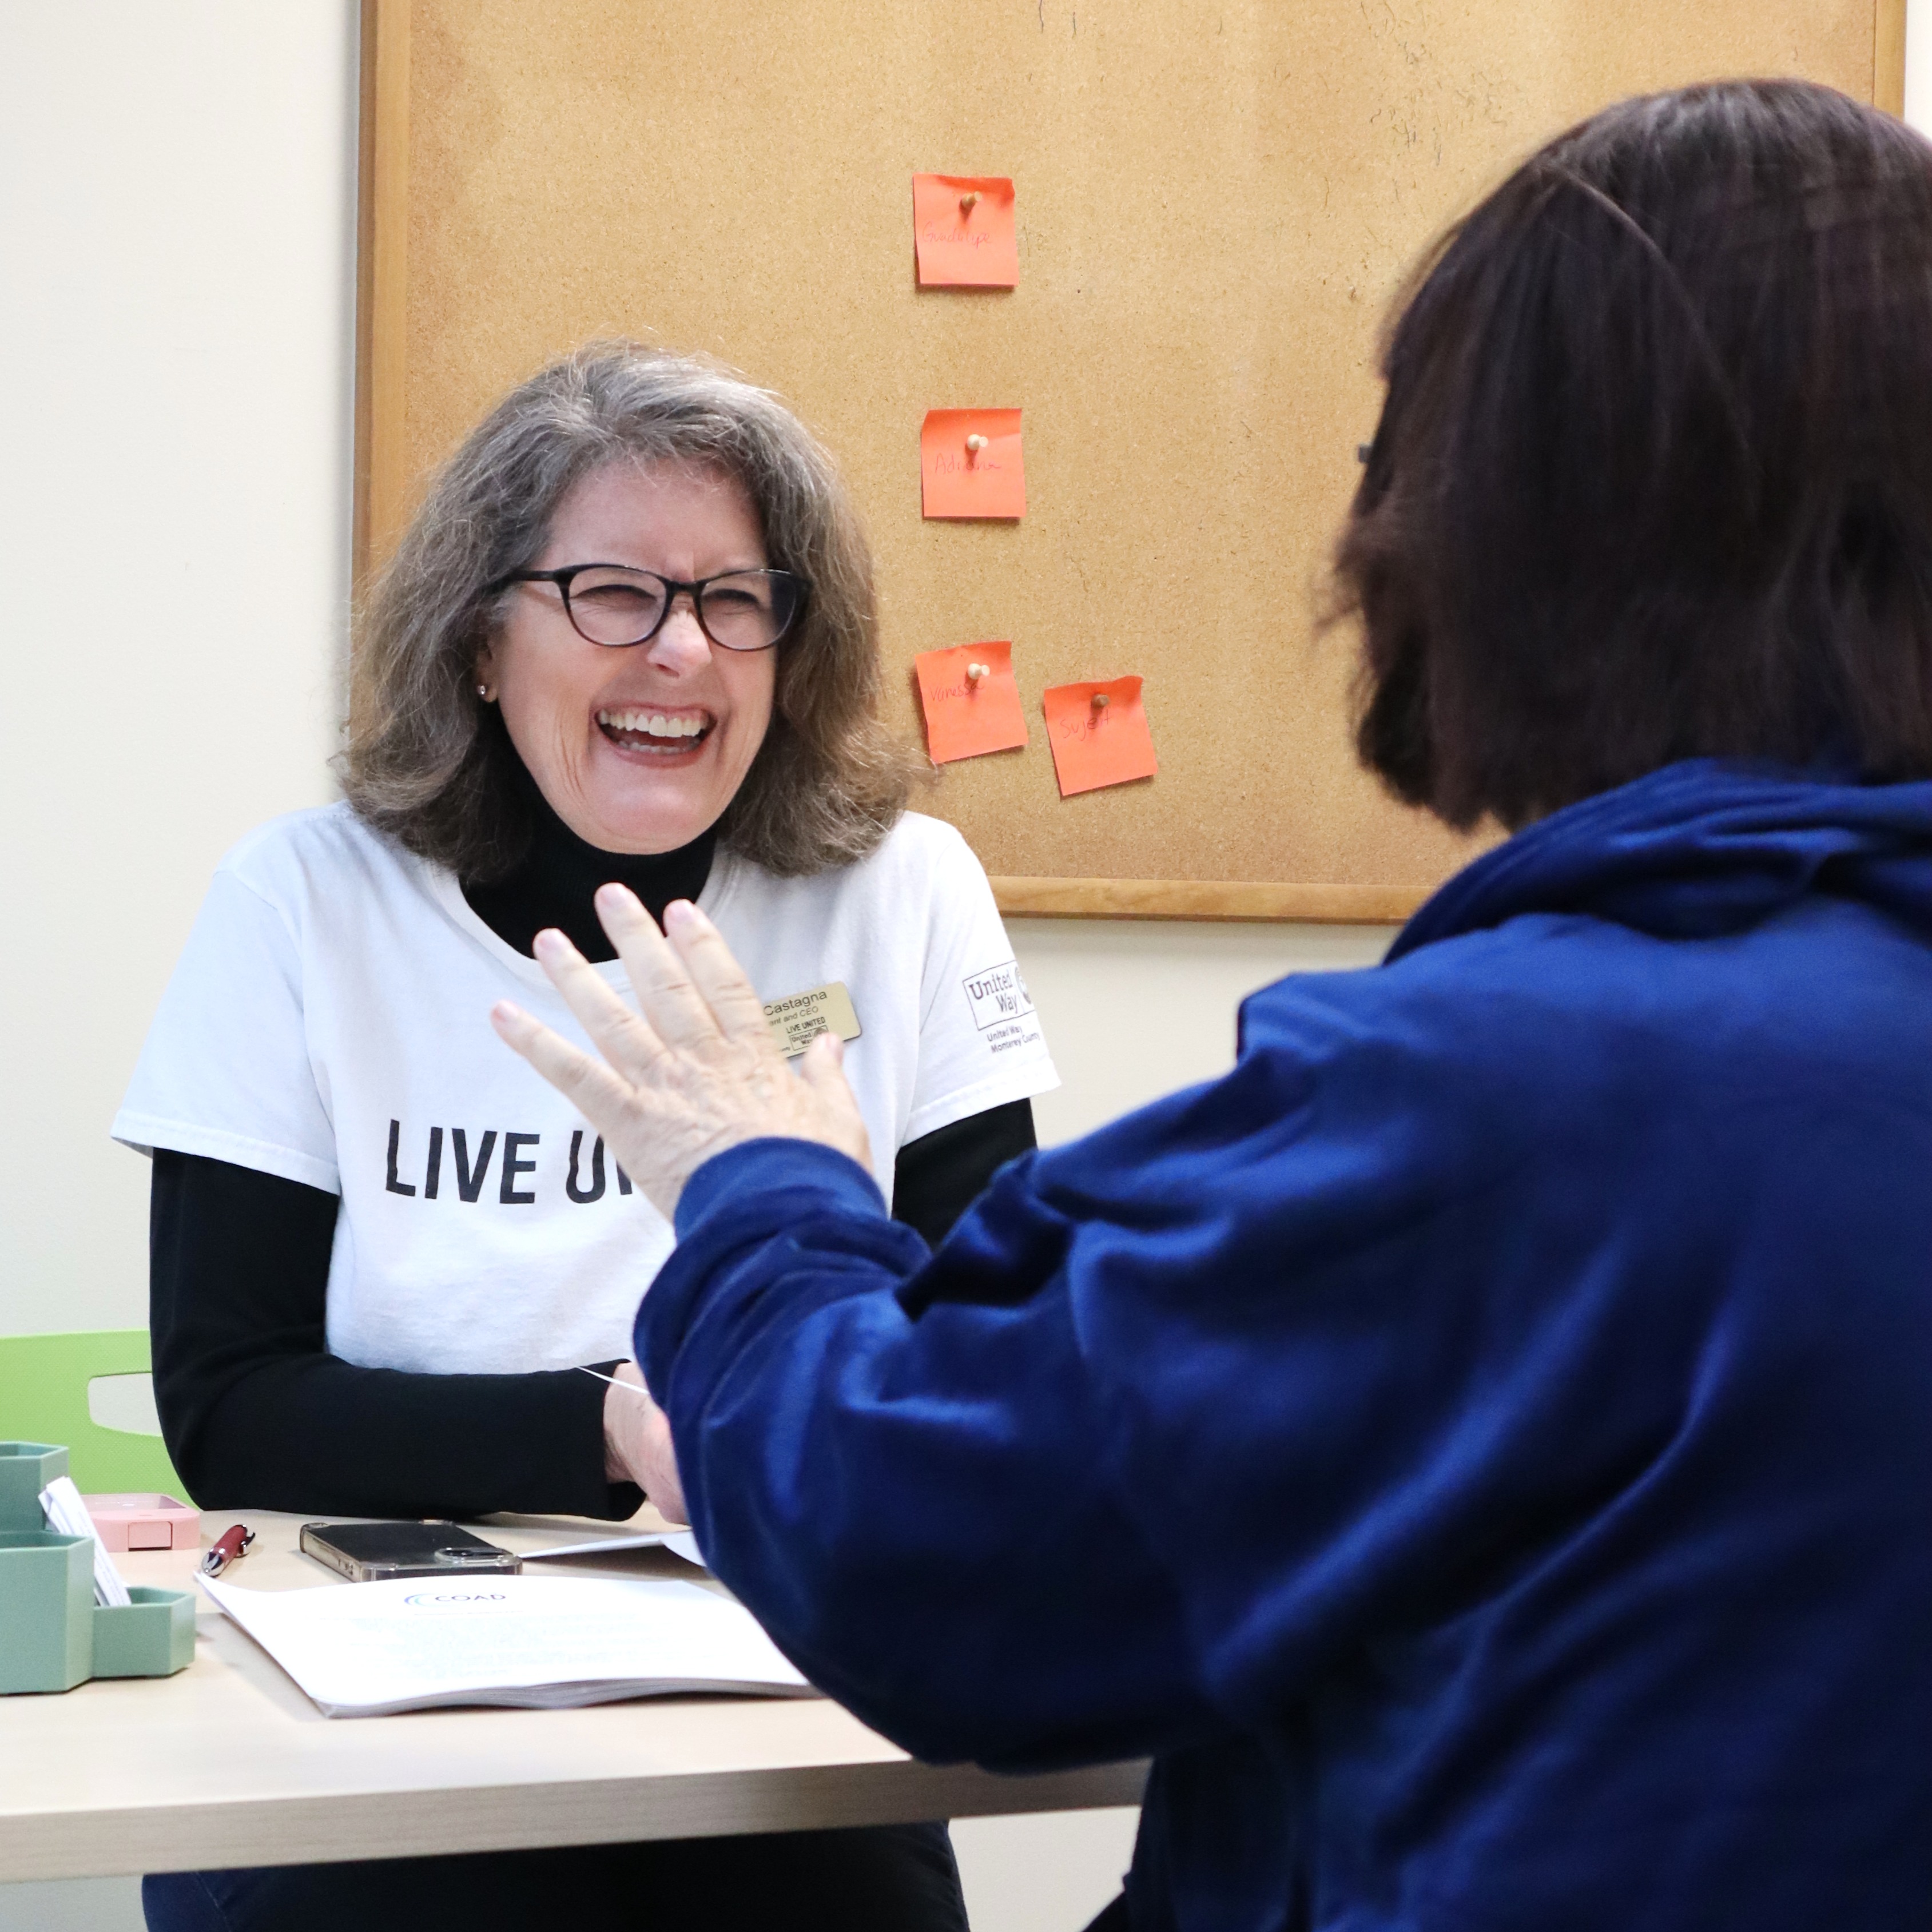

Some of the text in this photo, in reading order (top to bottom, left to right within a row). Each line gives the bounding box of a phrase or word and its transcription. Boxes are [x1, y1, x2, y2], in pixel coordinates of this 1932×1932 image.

[968, 969, 1013, 1000] United
[763, 991, 828, 1016] Castagna
[996, 993, 1018, 1014] Way
[784, 1012, 798, 1023] and
[800, 1006, 819, 1017] CEO
[786, 1016, 826, 1034] LIVE UNITED
[987, 1025, 1023, 1042] United Way
[791, 1032, 812, 1043] United
[991, 1037, 1022, 1054] Monterey
[385, 1119, 633, 1204] LIVE U
[435, 1594, 506, 1602] COAD
